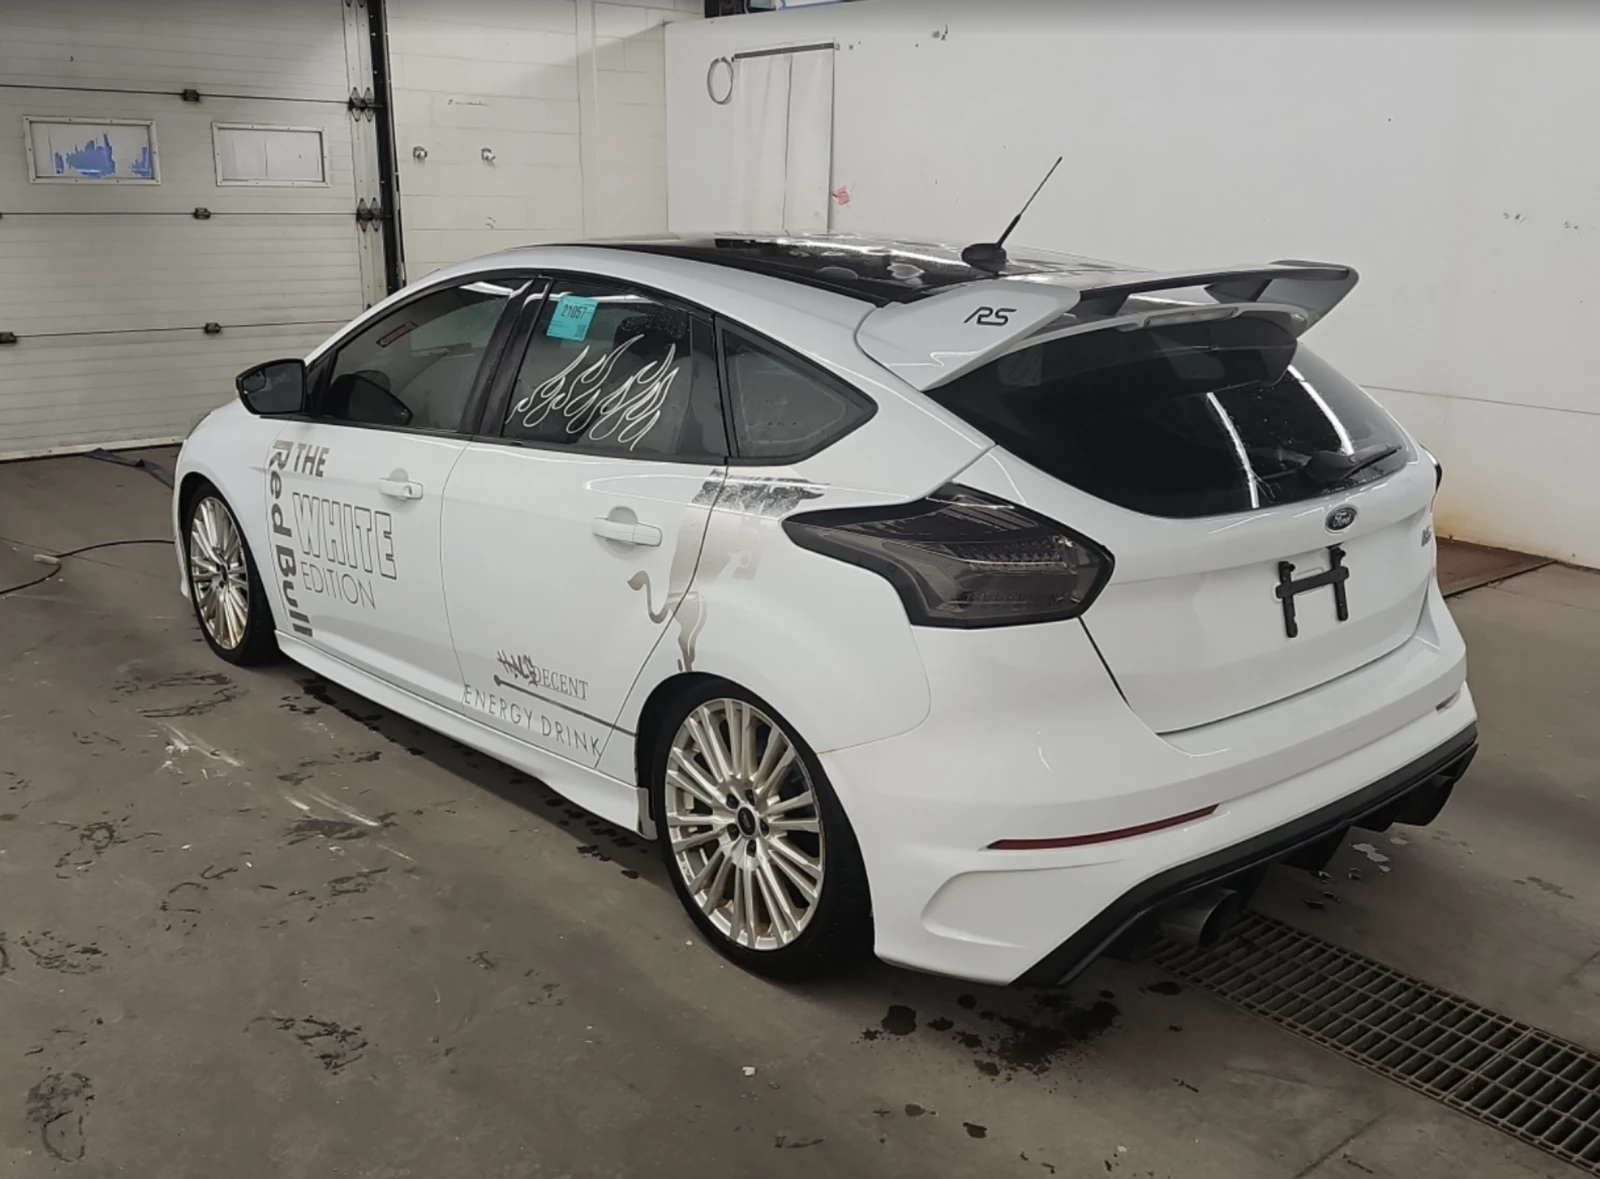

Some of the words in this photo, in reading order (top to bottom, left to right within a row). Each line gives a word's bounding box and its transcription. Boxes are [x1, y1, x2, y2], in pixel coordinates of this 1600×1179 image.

[963, 306, 1017, 326] RS
[268, 439, 294, 538] Red
[293, 443, 330, 478] THE
[292, 492, 397, 580] WHITE
[275, 544, 313, 638] Bull
[301, 561, 376, 610] EDITION
[465, 684, 533, 729] ENERGY
[541, 714, 601, 756] DRINK
